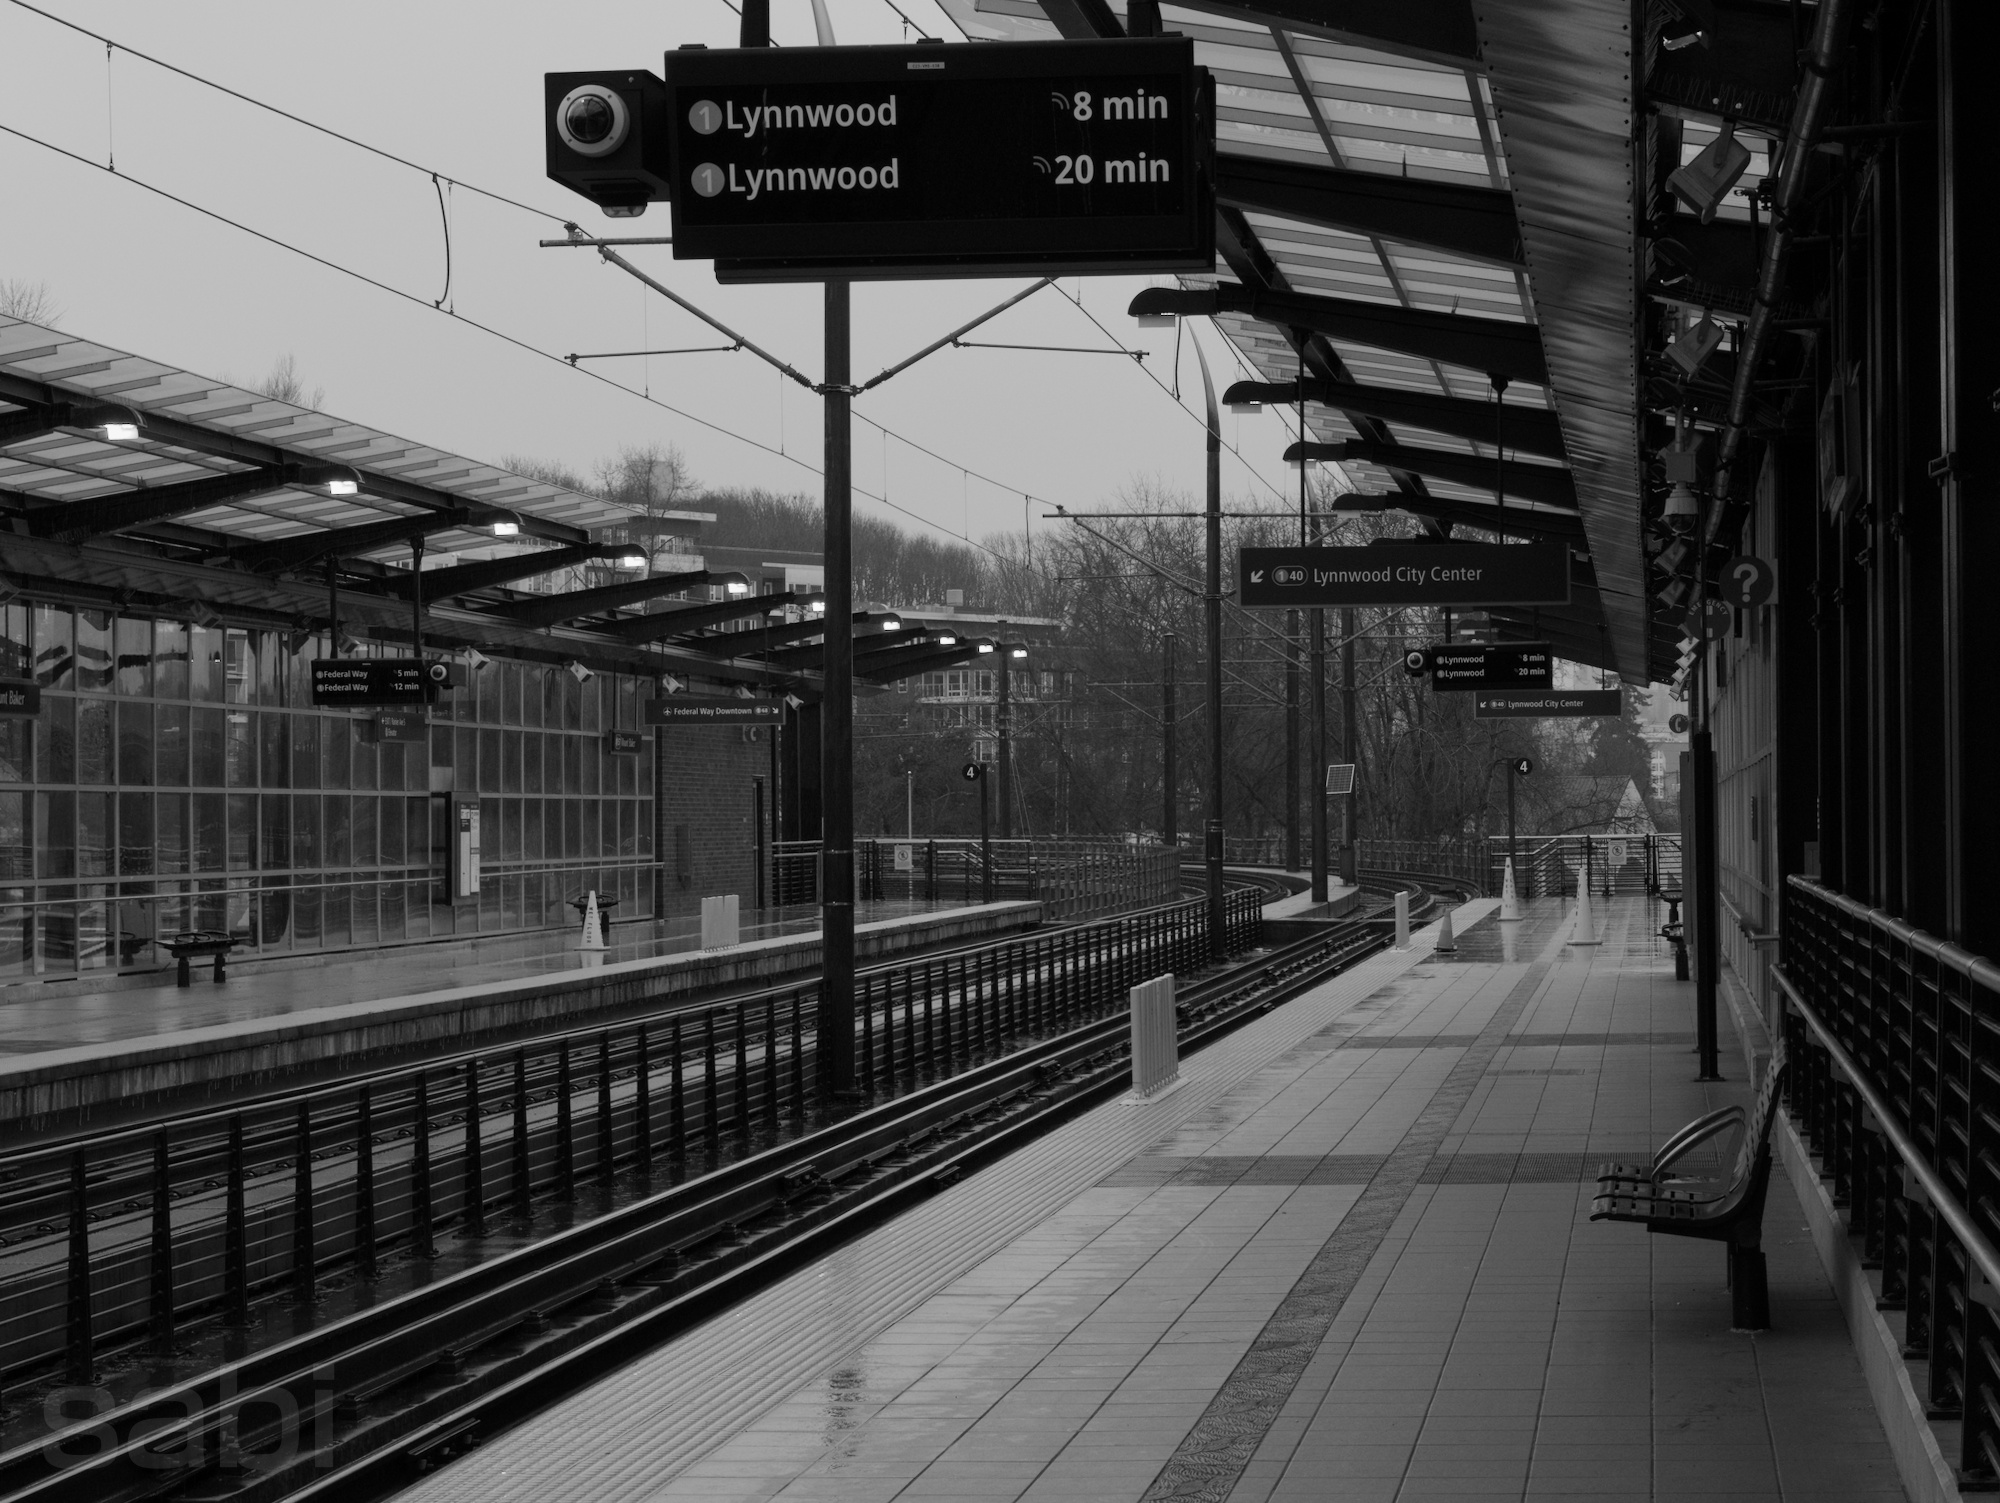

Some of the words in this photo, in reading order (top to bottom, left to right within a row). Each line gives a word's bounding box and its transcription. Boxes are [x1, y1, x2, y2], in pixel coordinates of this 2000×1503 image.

[726, 94, 897, 138] Lynnwood
[1073, 91, 1093, 121] 8
[1103, 88, 1168, 120] min
[728, 157, 899, 201] Lynnwood
[1054, 154, 1094, 185] 20
[1104, 151, 1170, 183] min
[1289, 570, 1303, 580] 40
[1313, 566, 1391, 587] Lynnwood
[1396, 566, 1426, 585] City
[1430, 566, 1482, 582] Center
[1688, 599, 1729, 616] EMEGENCY
[1444, 655, 1484, 665] Lynnwood
[1522, 654, 1528, 662] 8
[1529, 653, 1545, 662] min
[323, 670, 351, 679] Federal
[351, 670, 369, 680] Way
[397, 669, 403, 677] 5
[404, 668, 419, 677] min
[1445, 669, 1485, 679] Lynnwood
[1518, 667, 1529, 676] 20
[1530, 667, 1546, 676] min
[324, 683, 351, 692] Federal
[352, 683, 369, 693] Way
[394, 682, 403, 690] 12
[404, 681, 419, 690] min
[1508, 700, 1543, 709] Lynnwood
[1544, 699, 1559, 709] City
[1560, 699, 1584, 707] Center
[673, 707, 699, 715] Federal
[700, 707, 714, 716] Way
[715, 707, 752, 715] Downtown
[966, 766, 975, 778] 4
[1519, 760, 1528, 773] 4
